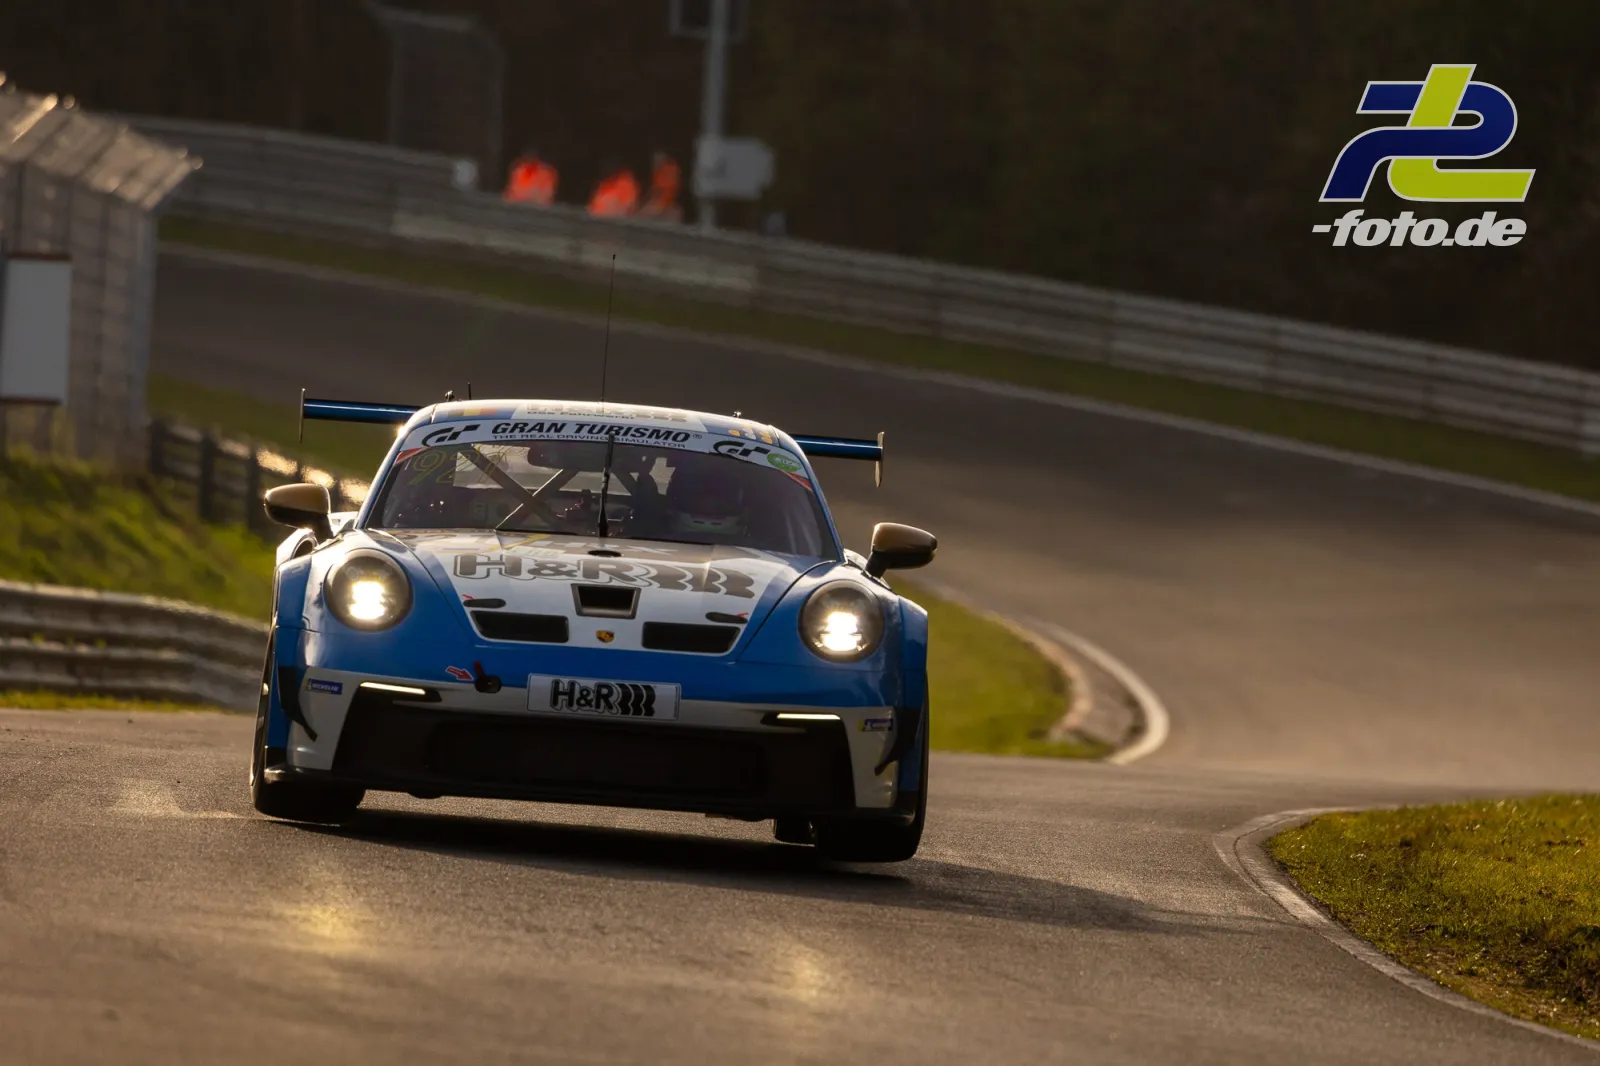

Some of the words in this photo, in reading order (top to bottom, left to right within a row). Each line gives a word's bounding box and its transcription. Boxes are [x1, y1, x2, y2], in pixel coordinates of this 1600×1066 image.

[491, 422, 564, 434] GRAN
[557, 433, 609, 442] DRIVING
[613, 436, 686, 449] SIMULATOR
